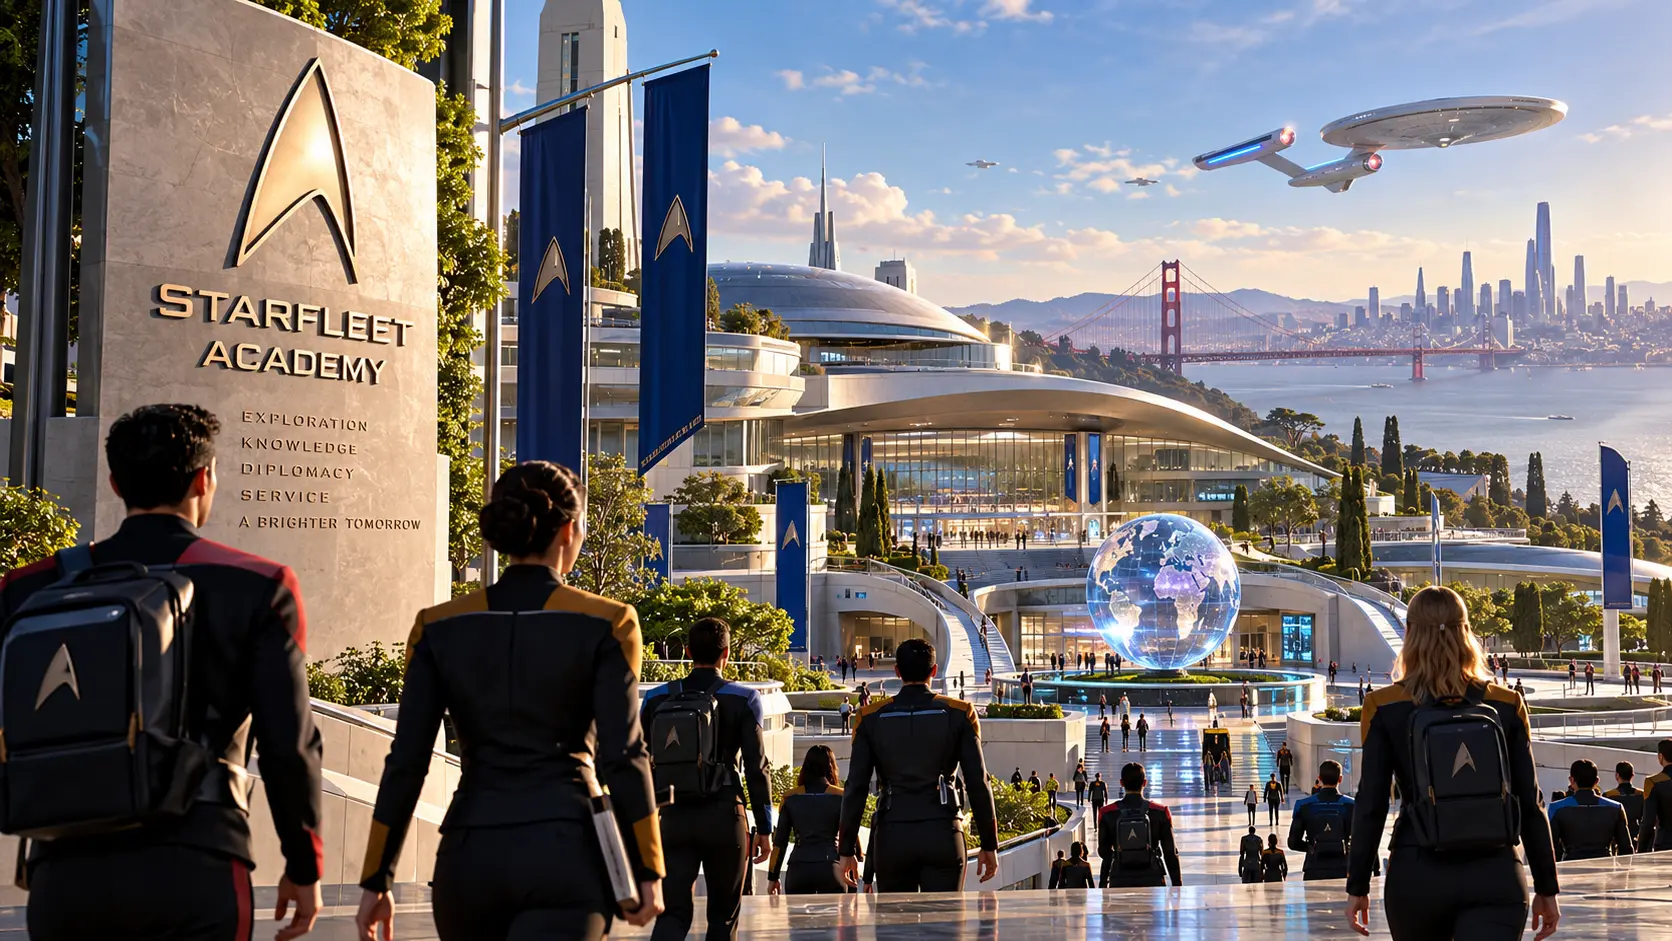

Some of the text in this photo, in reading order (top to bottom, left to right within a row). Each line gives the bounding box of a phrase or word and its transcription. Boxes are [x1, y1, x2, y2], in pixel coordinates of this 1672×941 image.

[156, 283, 415, 348] STARFLEET
[200, 340, 388, 385] ACADEMY
[242, 410, 369, 432] EXPLORATION
[241, 437, 358, 456] KNOWLEDGE
[241, 463, 355, 480] DIPLOMACY
[240, 489, 331, 504] SERVICE
[238, 515, 422, 531] A BRIGHTER TOMORROW
